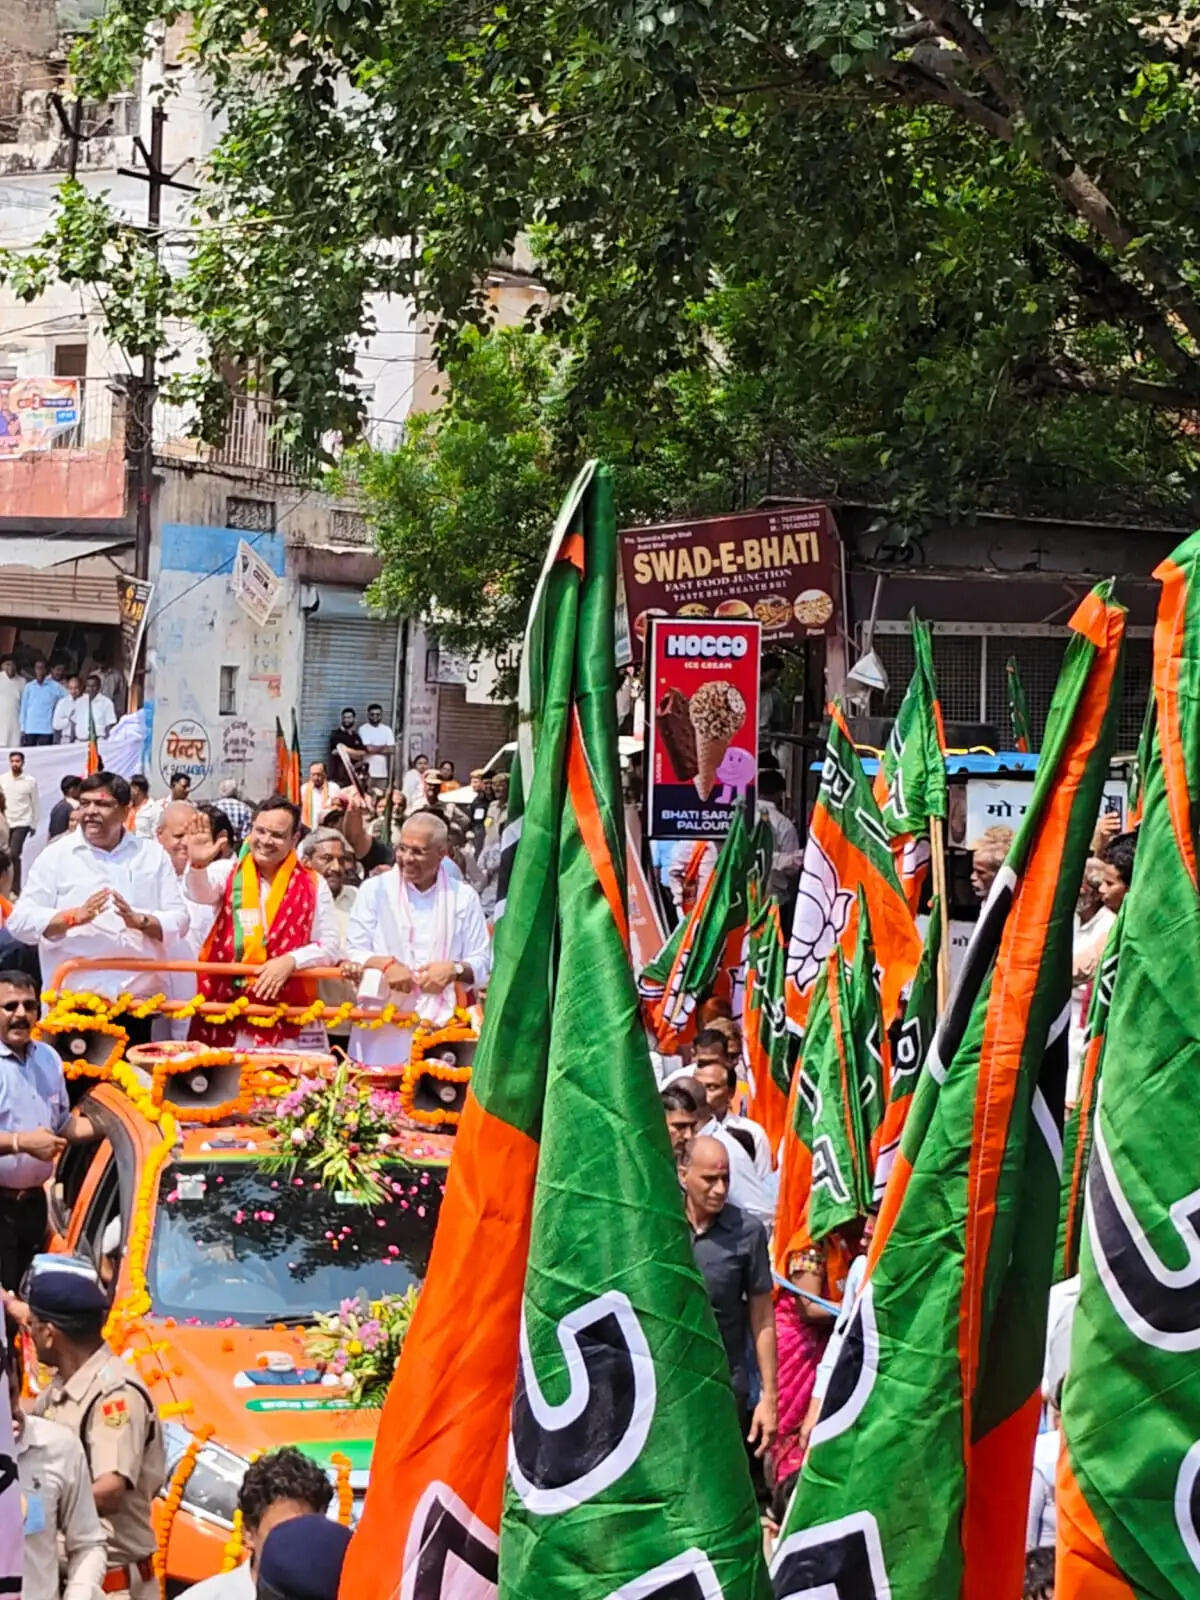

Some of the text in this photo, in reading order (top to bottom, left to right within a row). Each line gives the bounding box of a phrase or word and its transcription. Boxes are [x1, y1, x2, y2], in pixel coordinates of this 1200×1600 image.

[633, 532, 820, 584] SWAD-E-BHATI
[664, 568, 792, 592] FAST FOOD JUNCTION
[673, 591, 704, 602] TASTE
[729, 584, 768, 596] HEALTH
[666, 635, 748, 658] HOCCO
[684, 661, 732, 670] ICE CREAM
[661, 810, 699, 820] BHATI
[676, 820, 730, 831] PALOUR
